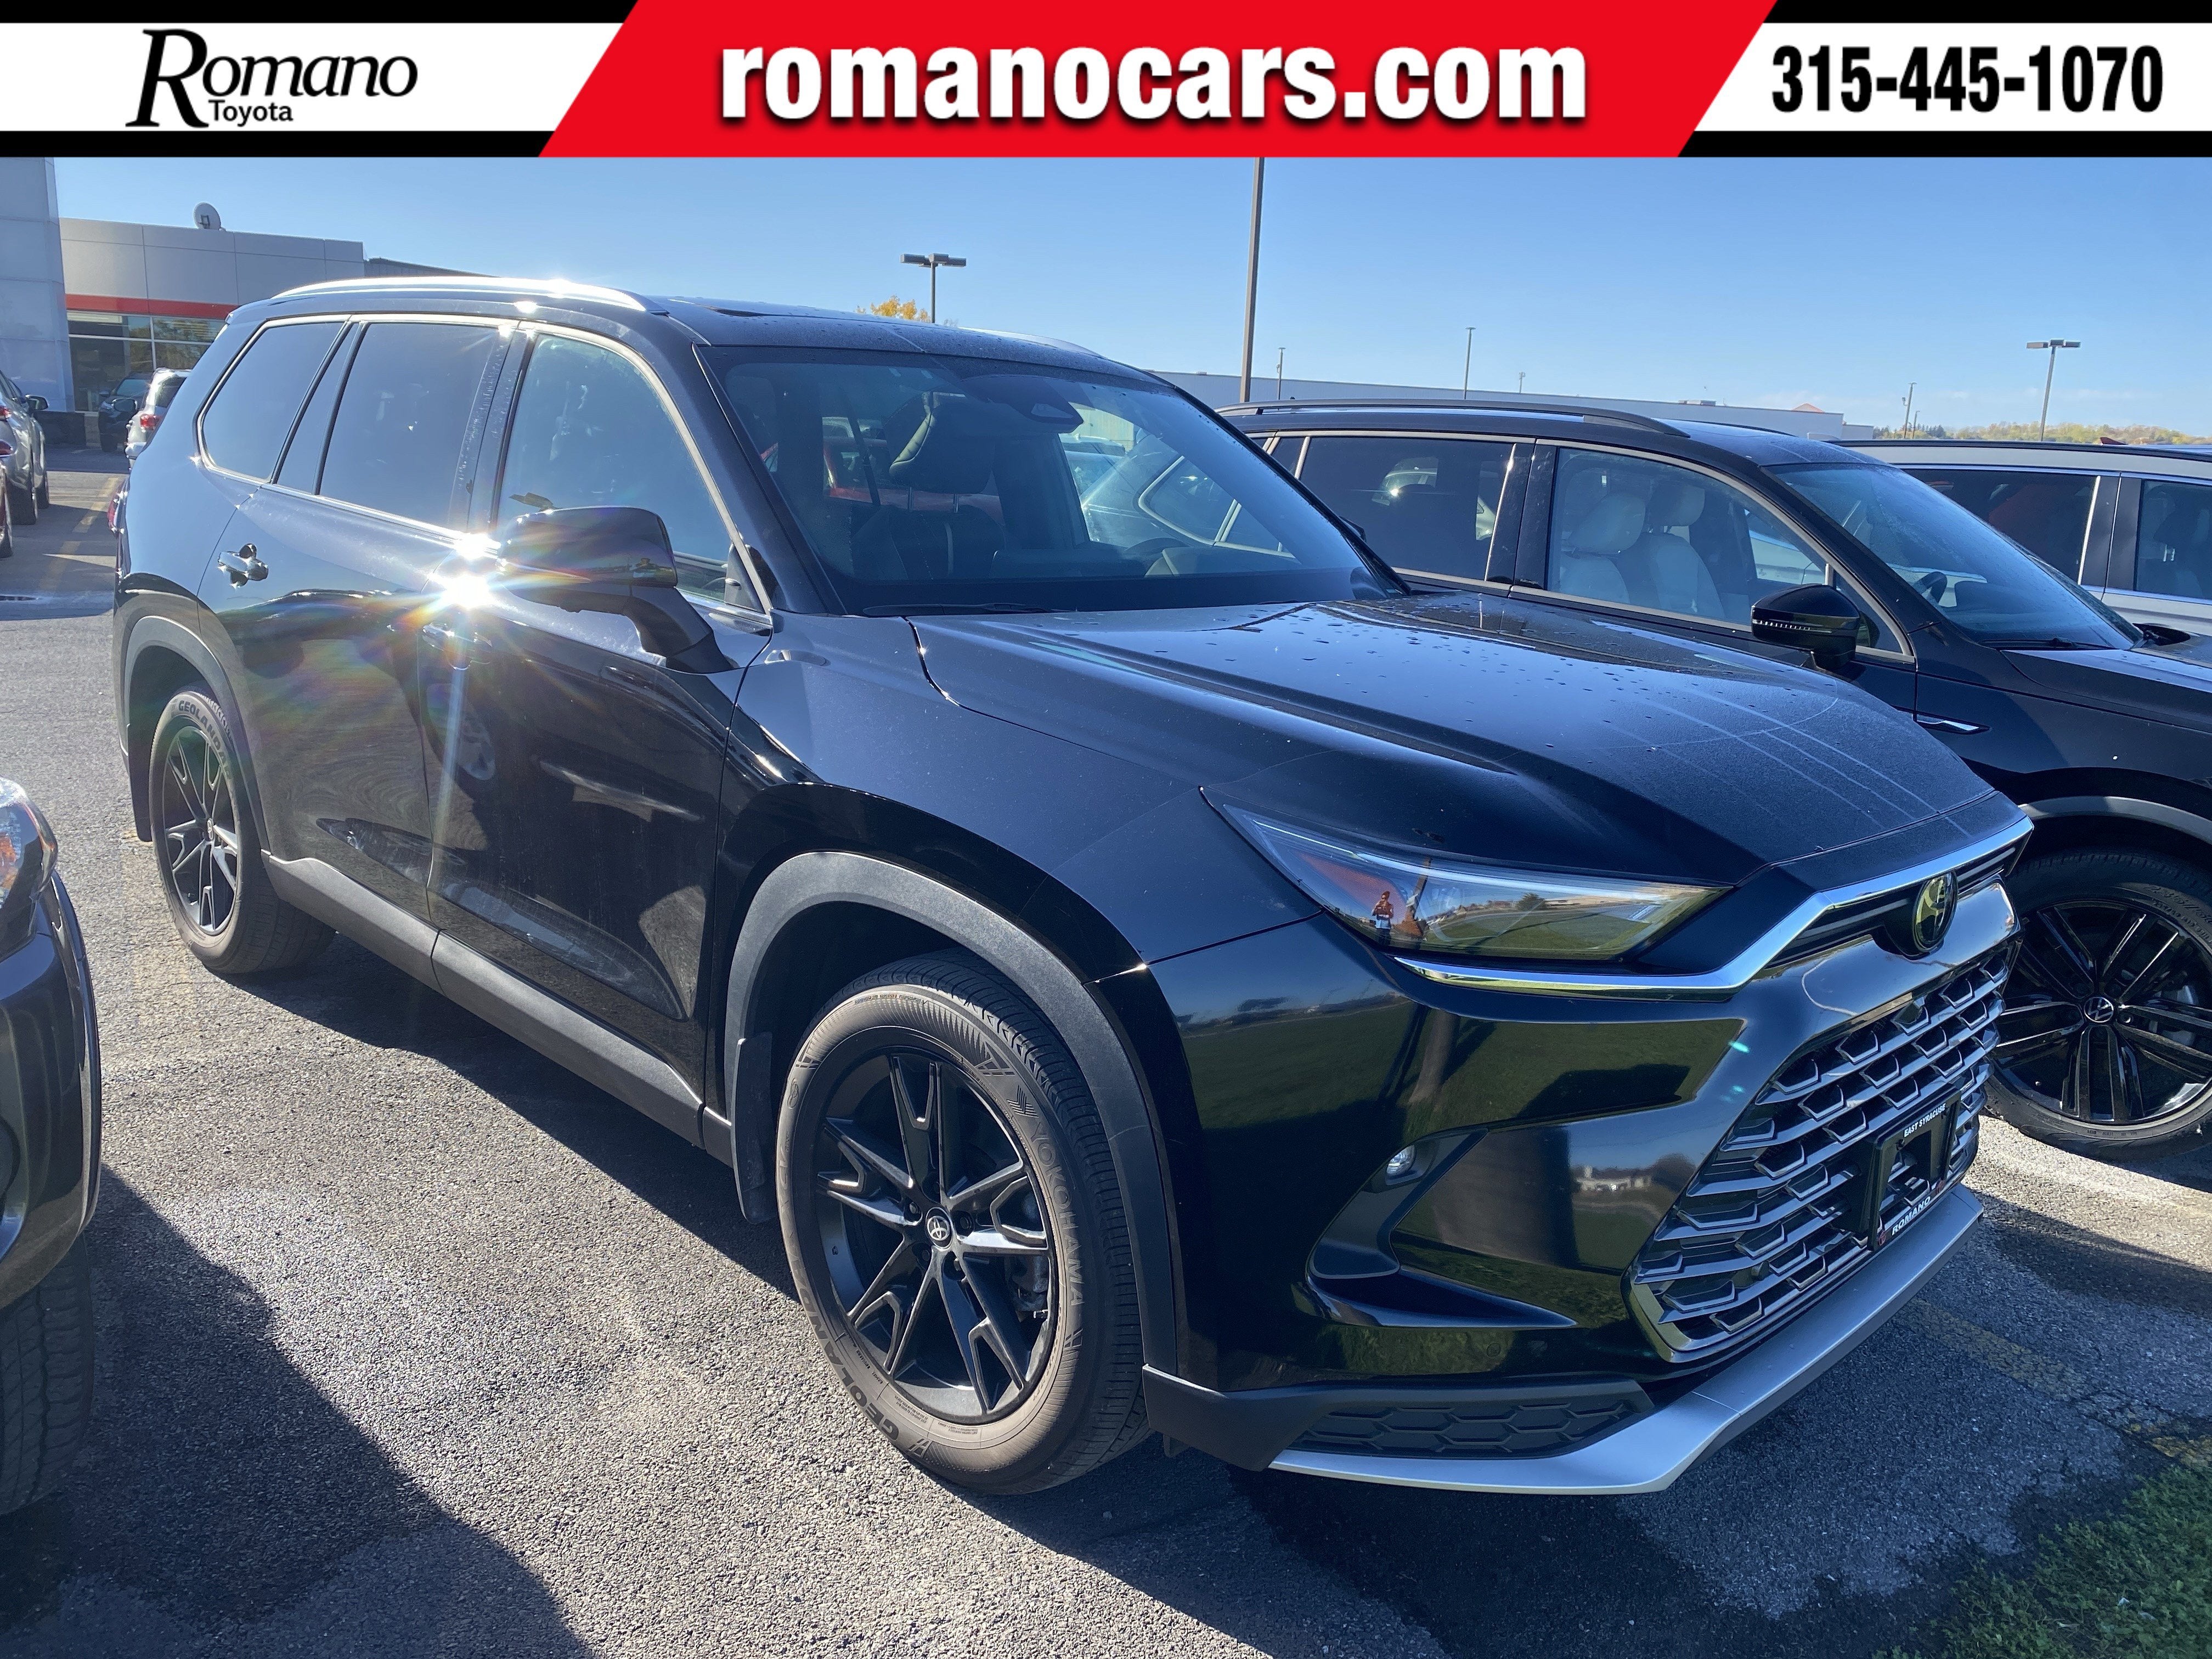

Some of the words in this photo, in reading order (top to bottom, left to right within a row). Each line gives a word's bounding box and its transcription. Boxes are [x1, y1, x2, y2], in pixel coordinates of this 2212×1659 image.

[1904, 1121, 1919, 1137] EAST
[1919, 1103, 1946, 1127] SYRACUSE
[1031, 1121, 1085, 1306] YOKOHAMA
[1892, 1196, 1931, 1236] ROMANO
